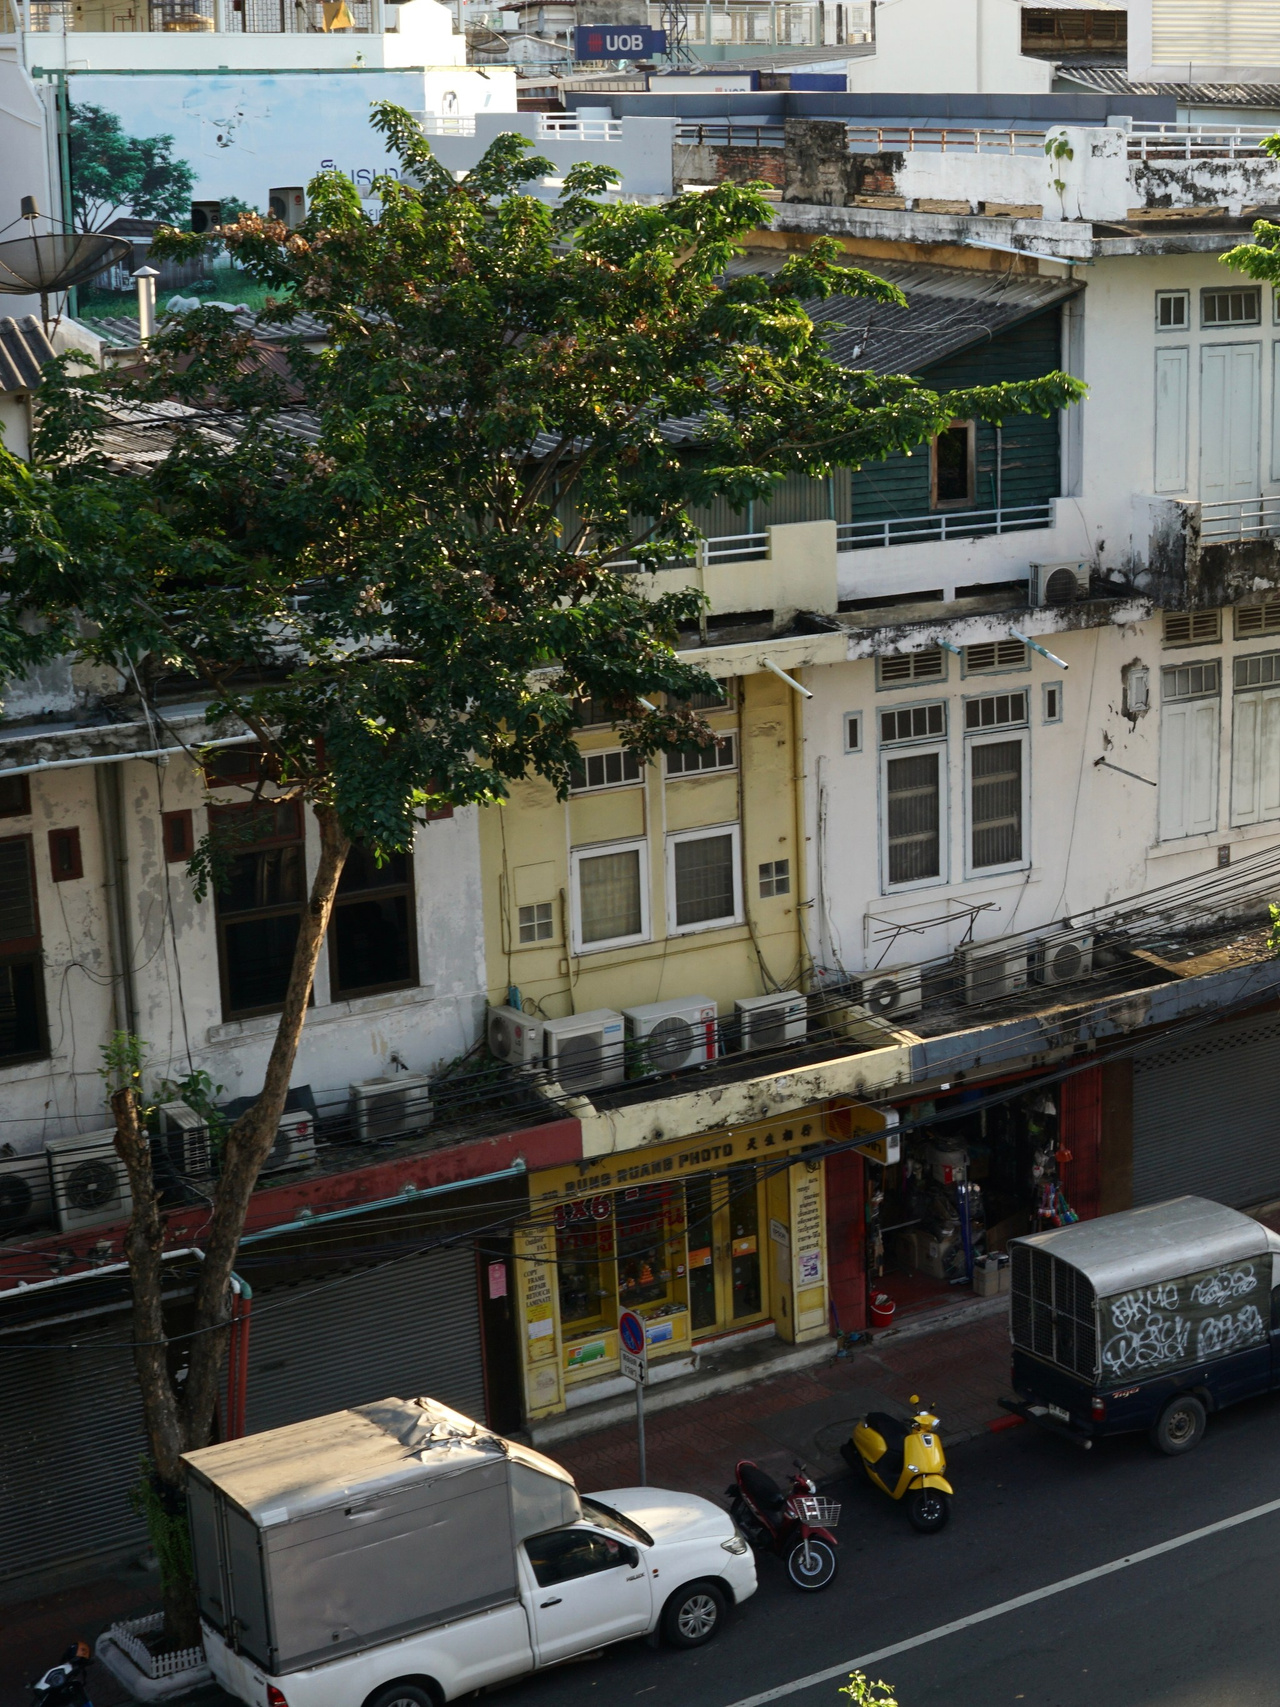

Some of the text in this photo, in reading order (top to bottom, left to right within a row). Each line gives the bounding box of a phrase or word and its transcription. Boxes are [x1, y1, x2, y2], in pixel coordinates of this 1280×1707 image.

[606, 35, 643, 51] UOB
[679, 1143, 733, 1168] PHOTO
[523, 1269, 538, 1278] COPY
[528, 1274, 545, 1284] FRAME
[528, 1282, 546, 1292] REPAIR
[526, 1289, 550, 1300] RETOUCH
[526, 1296, 551, 1308] LAMINATE
